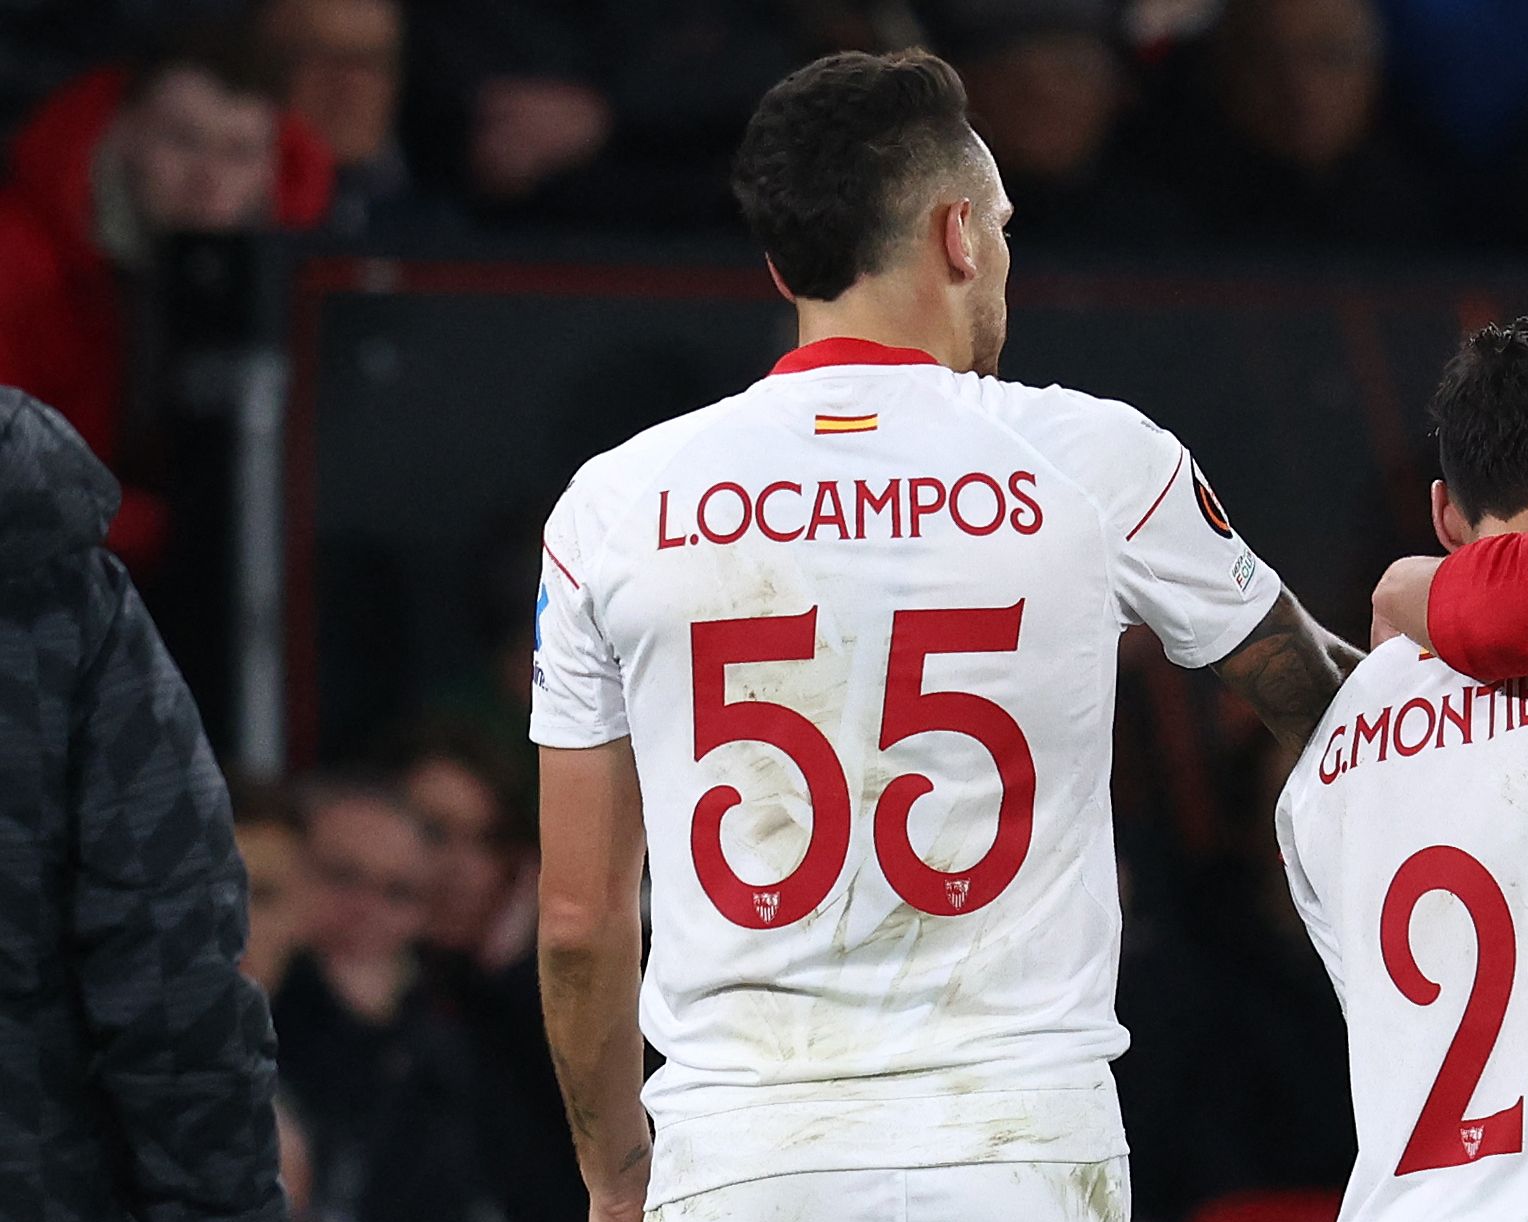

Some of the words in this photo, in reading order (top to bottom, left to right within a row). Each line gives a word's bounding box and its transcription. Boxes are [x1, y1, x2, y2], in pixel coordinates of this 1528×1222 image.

[657, 470, 1044, 551] L.OCAMPOS
[689, 597, 1037, 930] 55
[1380, 844, 1524, 1177] 2
